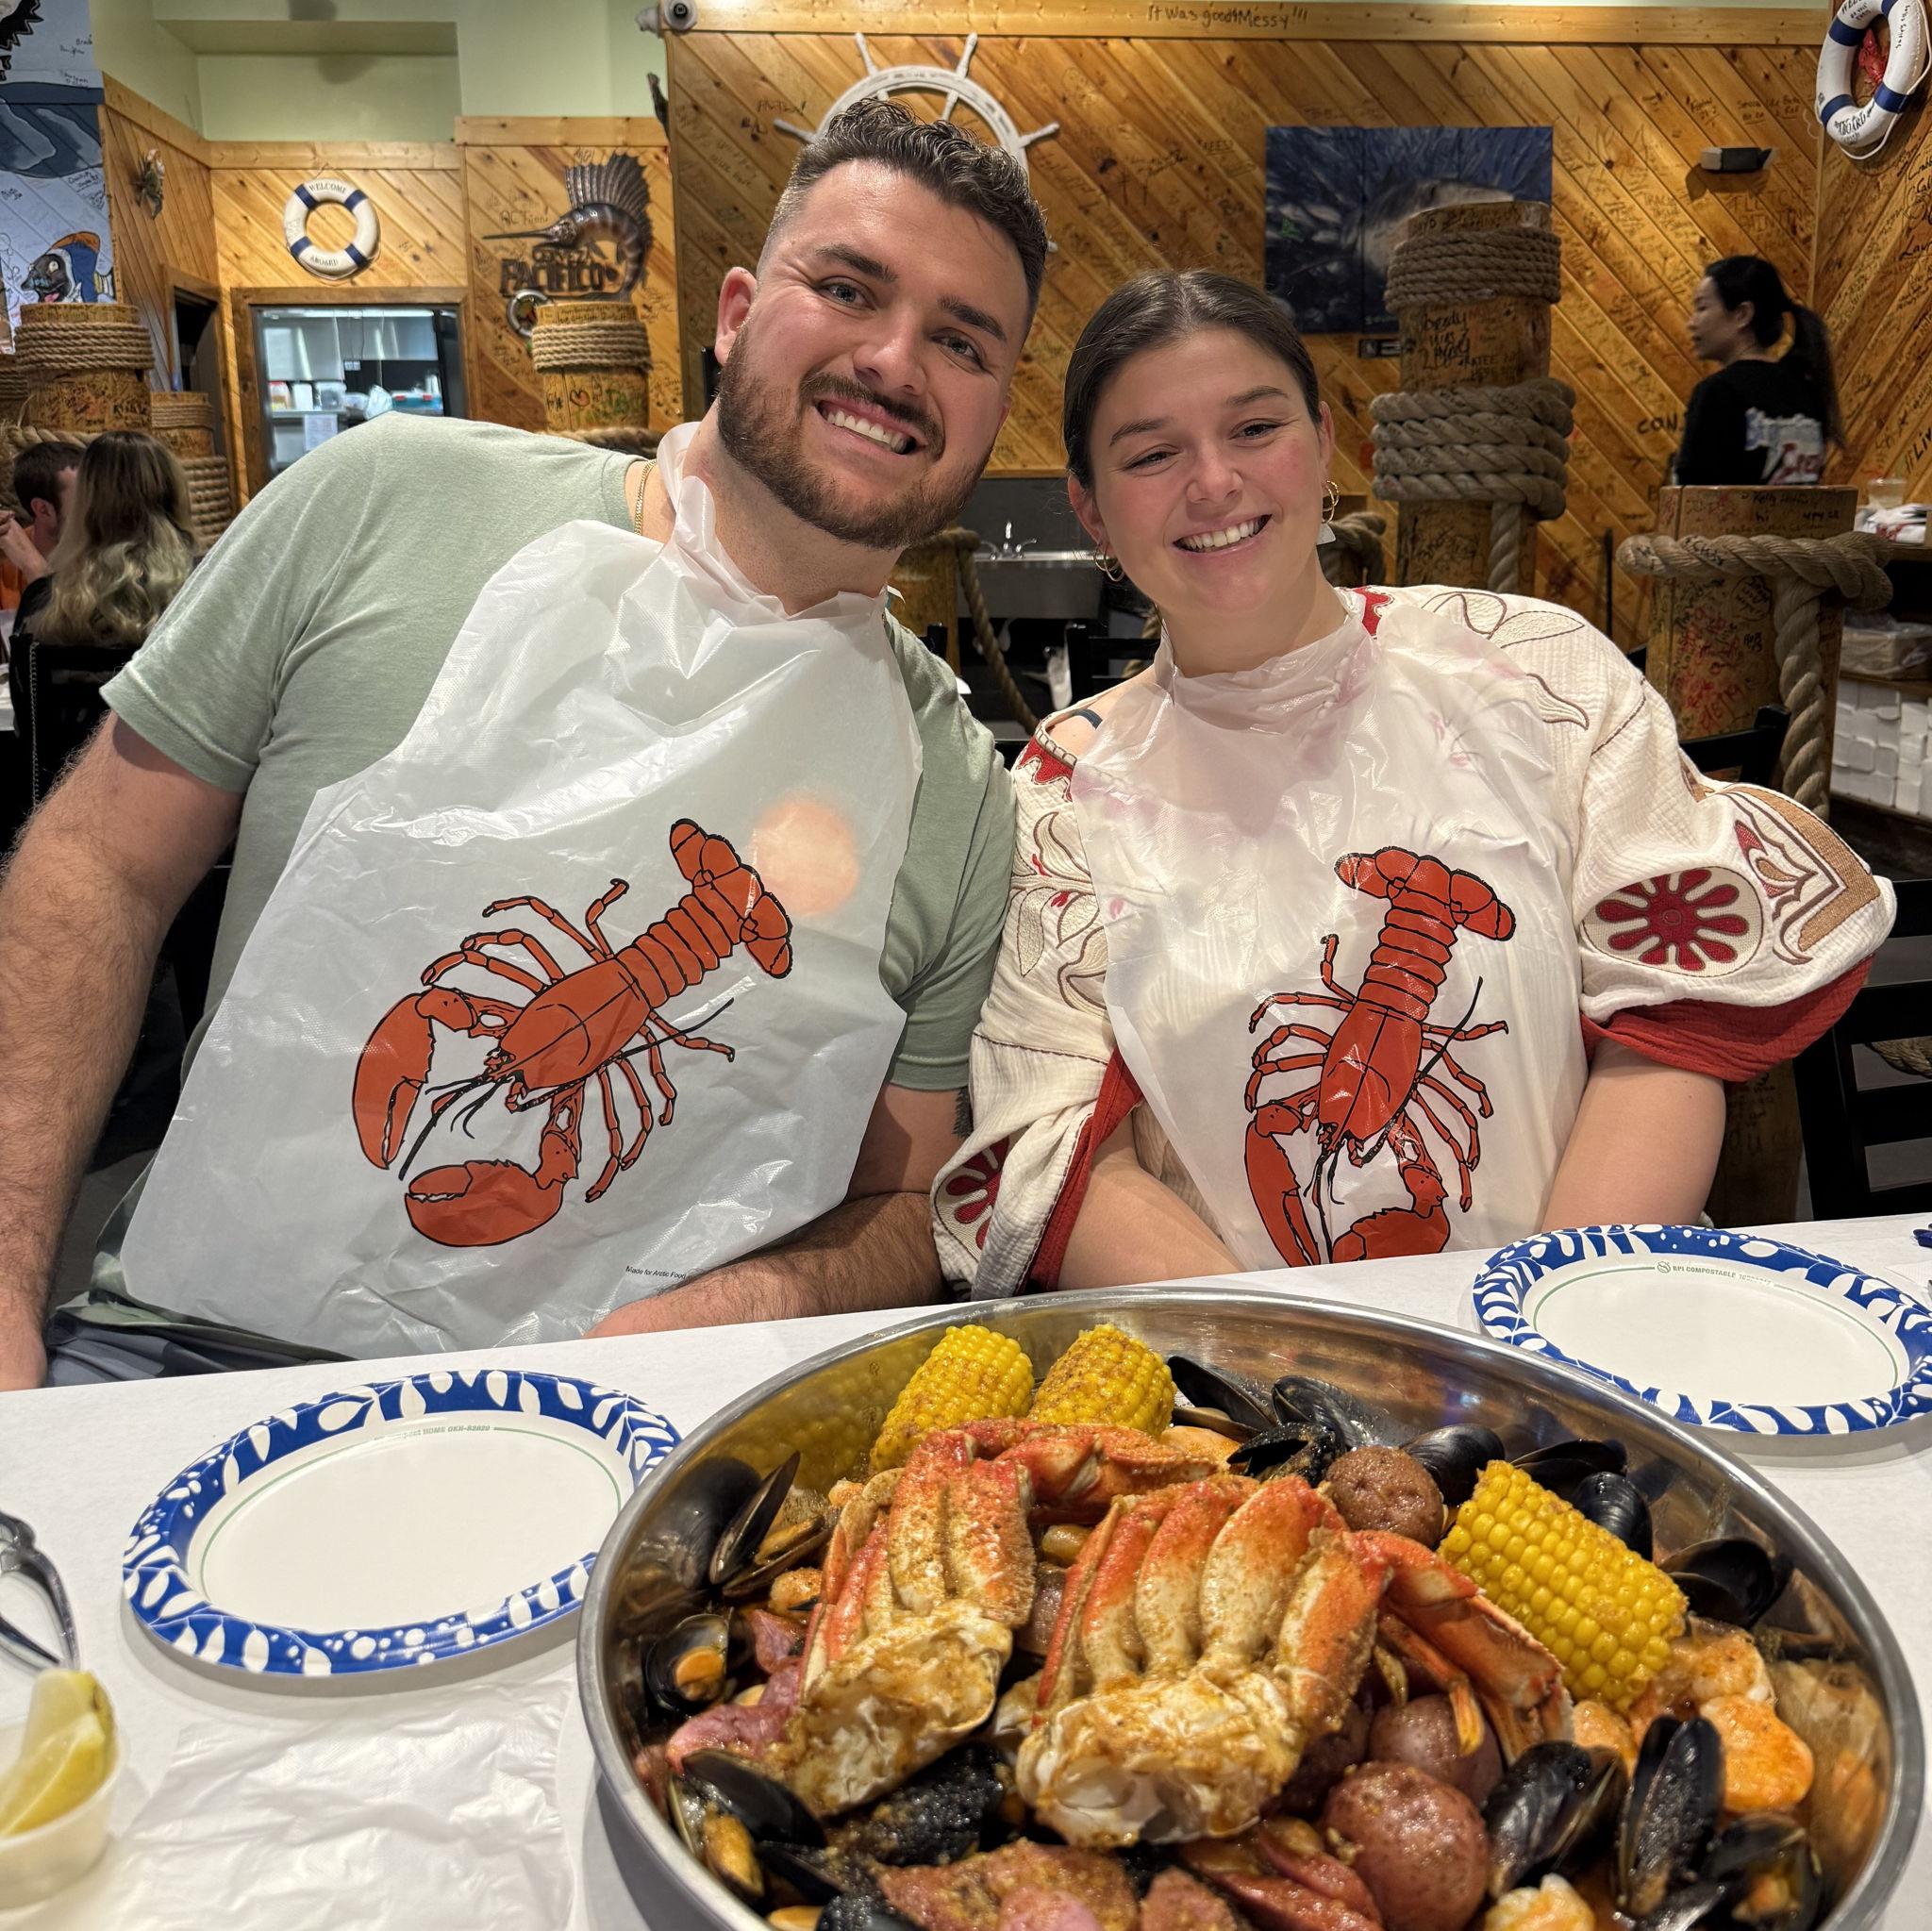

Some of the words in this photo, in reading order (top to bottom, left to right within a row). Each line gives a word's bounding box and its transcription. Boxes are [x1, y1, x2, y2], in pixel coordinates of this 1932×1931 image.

[308, 182, 346, 193] WELCOME
[309, 256, 339, 266] ABOARD
[500, 258, 604, 297] PACIFICO
[625, 1265, 643, 1274] Made
[1686, 1266, 1736, 1277] COMPOSTABLE
